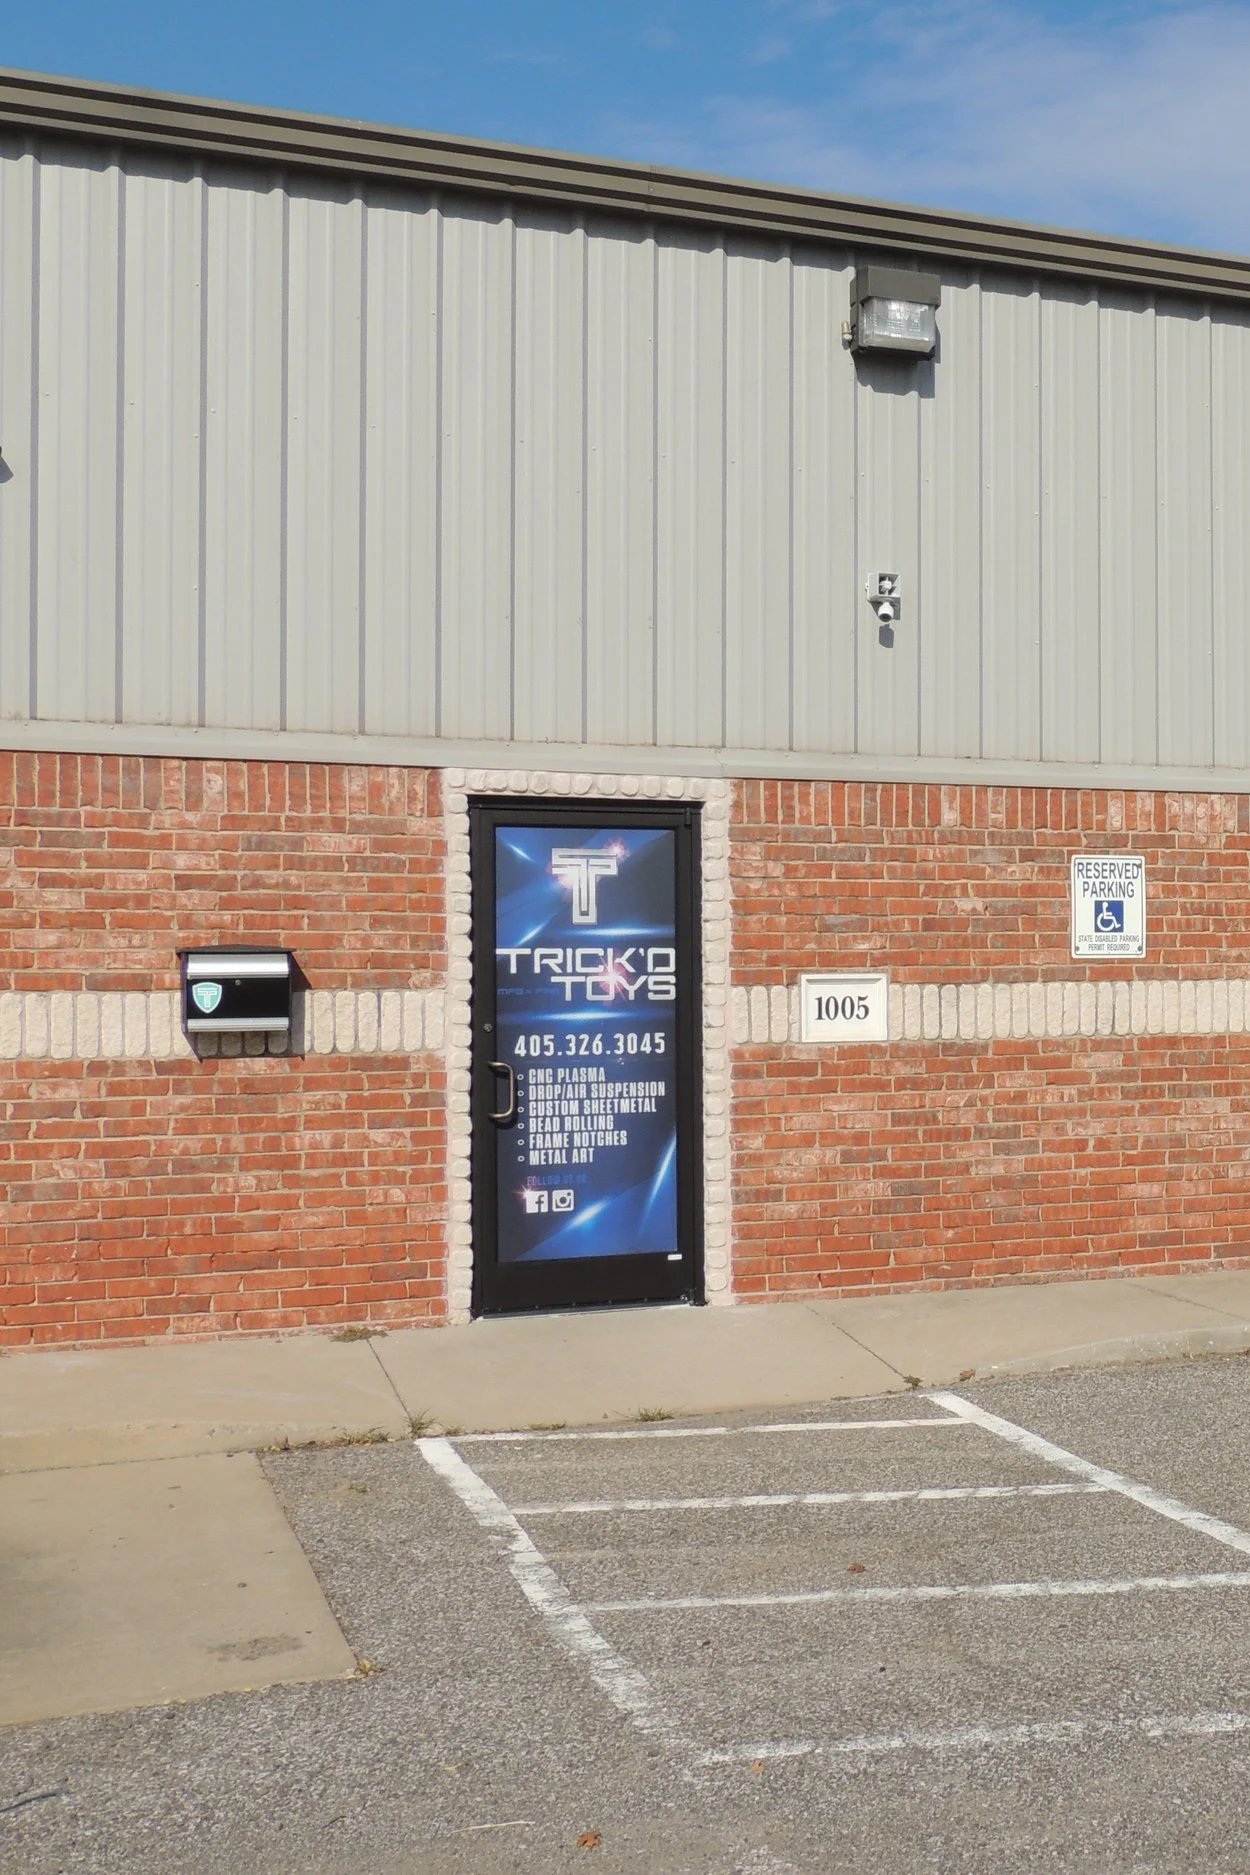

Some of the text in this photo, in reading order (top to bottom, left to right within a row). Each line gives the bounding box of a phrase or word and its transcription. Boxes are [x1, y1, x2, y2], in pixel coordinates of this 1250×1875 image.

[1077, 862, 1140, 880] RESERVED
[1082, 881, 1135, 898] PARKING
[1078, 934, 1140, 943] STATE DISABLED PARKING
[1088, 943, 1130, 951] PERMIT REQUIRED
[551, 975, 676, 1001] TOYS
[814, 995, 870, 1020] 1005
[514, 1032, 666, 1057] 405.326.3045
[528, 1067, 606, 1084] CNC PLASMA
[528, 1081, 666, 1100] DROP/AIR SUSPENSION
[529, 1098, 657, 1116] CUSTOM SHEETMETAL
[529, 1115, 614, 1133] BEAD ROLLING
[529, 1130, 628, 1149] FRAME NOTCHES
[529, 1148, 595, 1166] METAL ART
